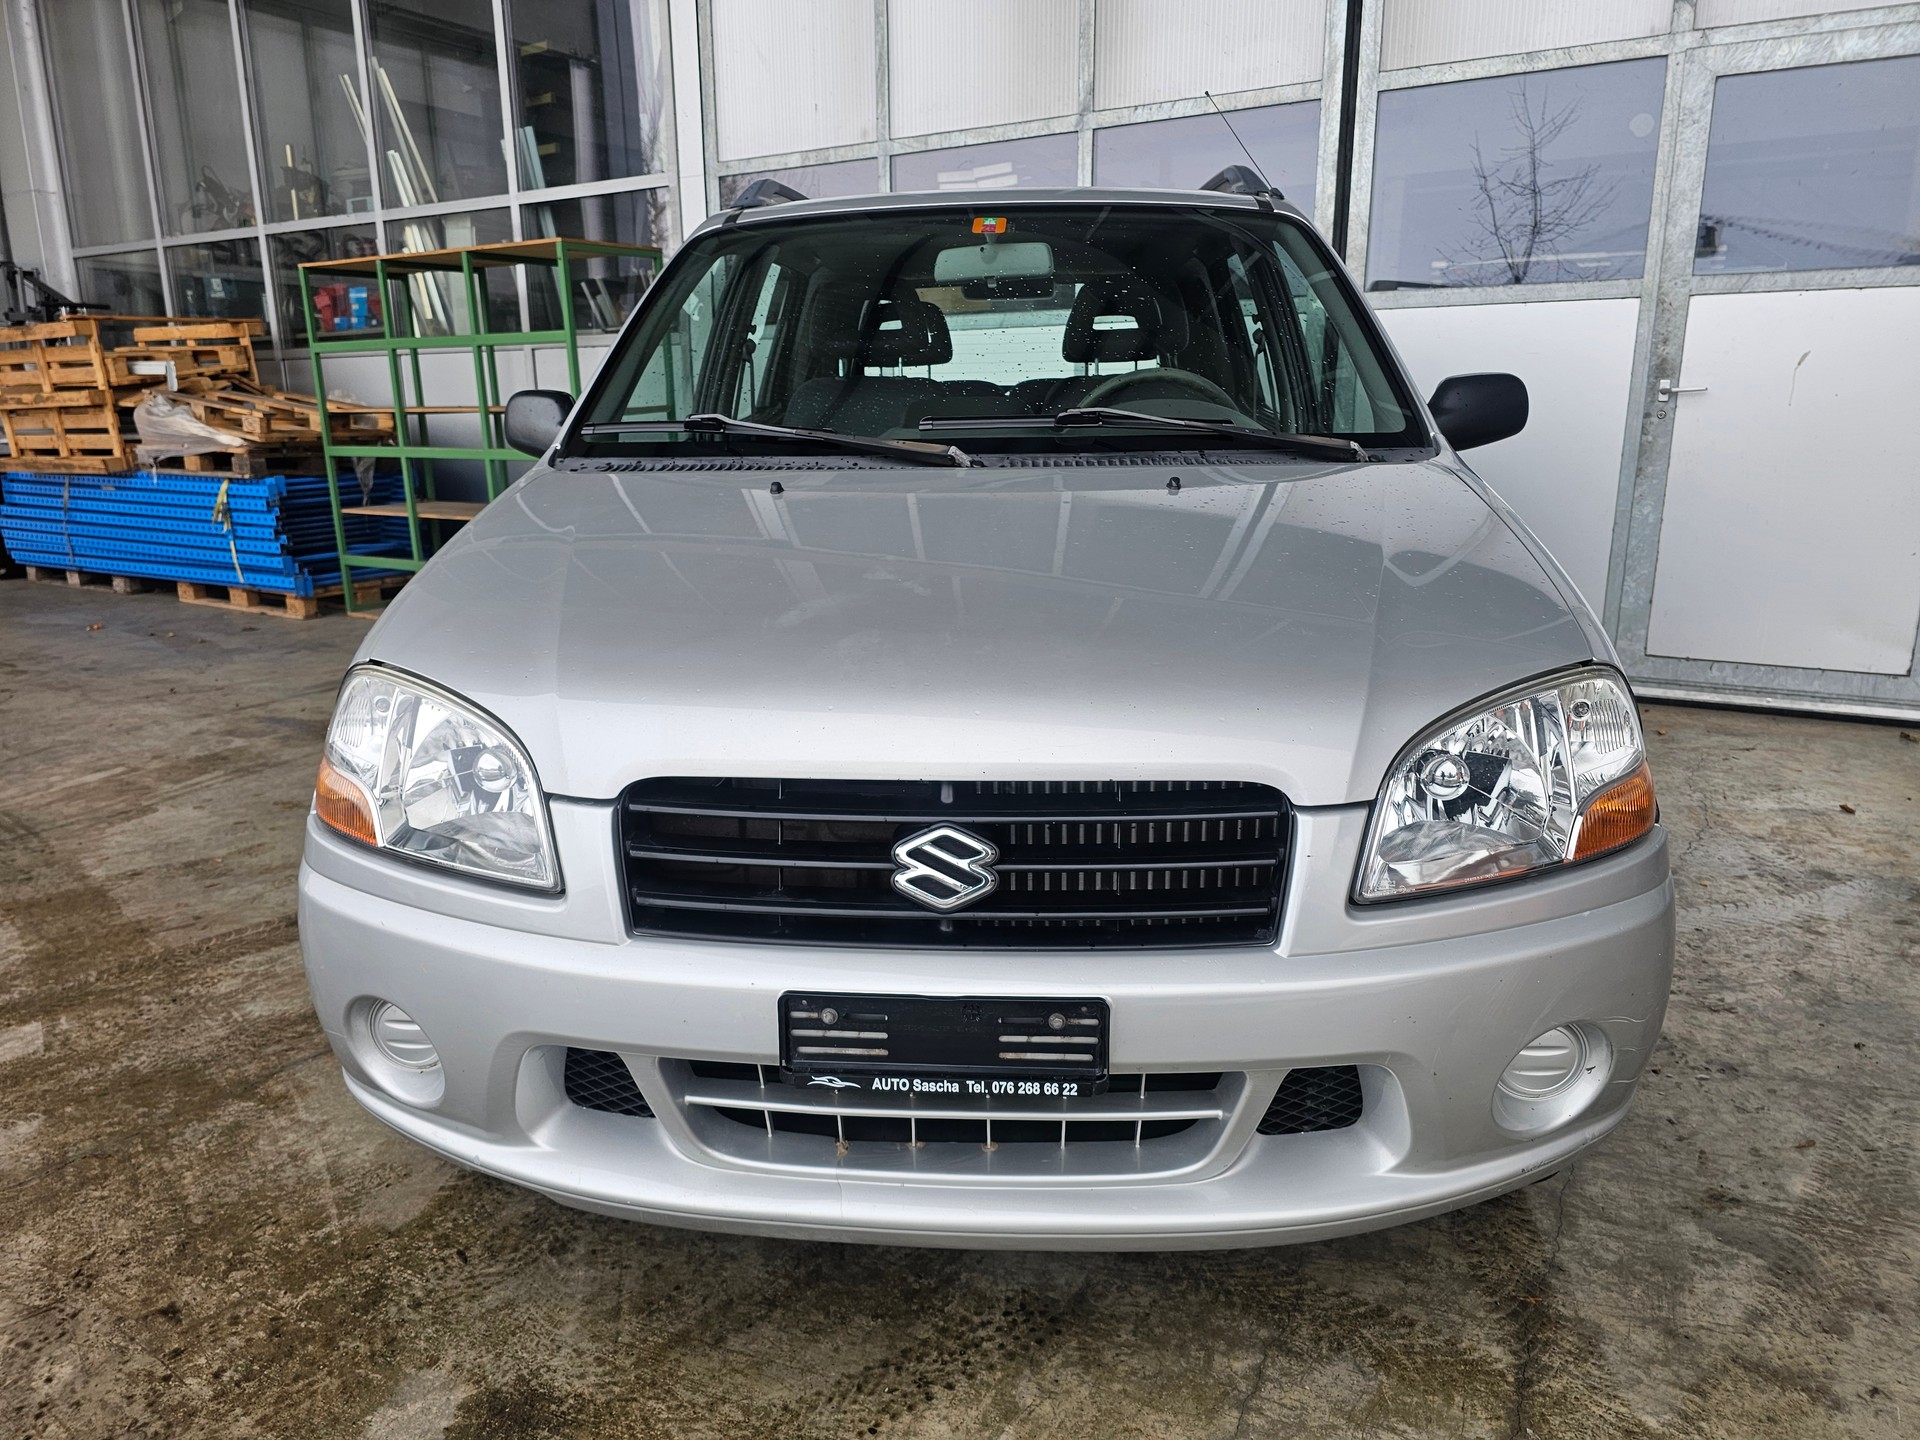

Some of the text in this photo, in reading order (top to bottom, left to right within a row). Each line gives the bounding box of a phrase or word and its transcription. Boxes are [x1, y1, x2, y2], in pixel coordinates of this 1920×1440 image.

[872, 1078, 1078, 1096] AUTO Sascha Tel. 076 268 66 22
